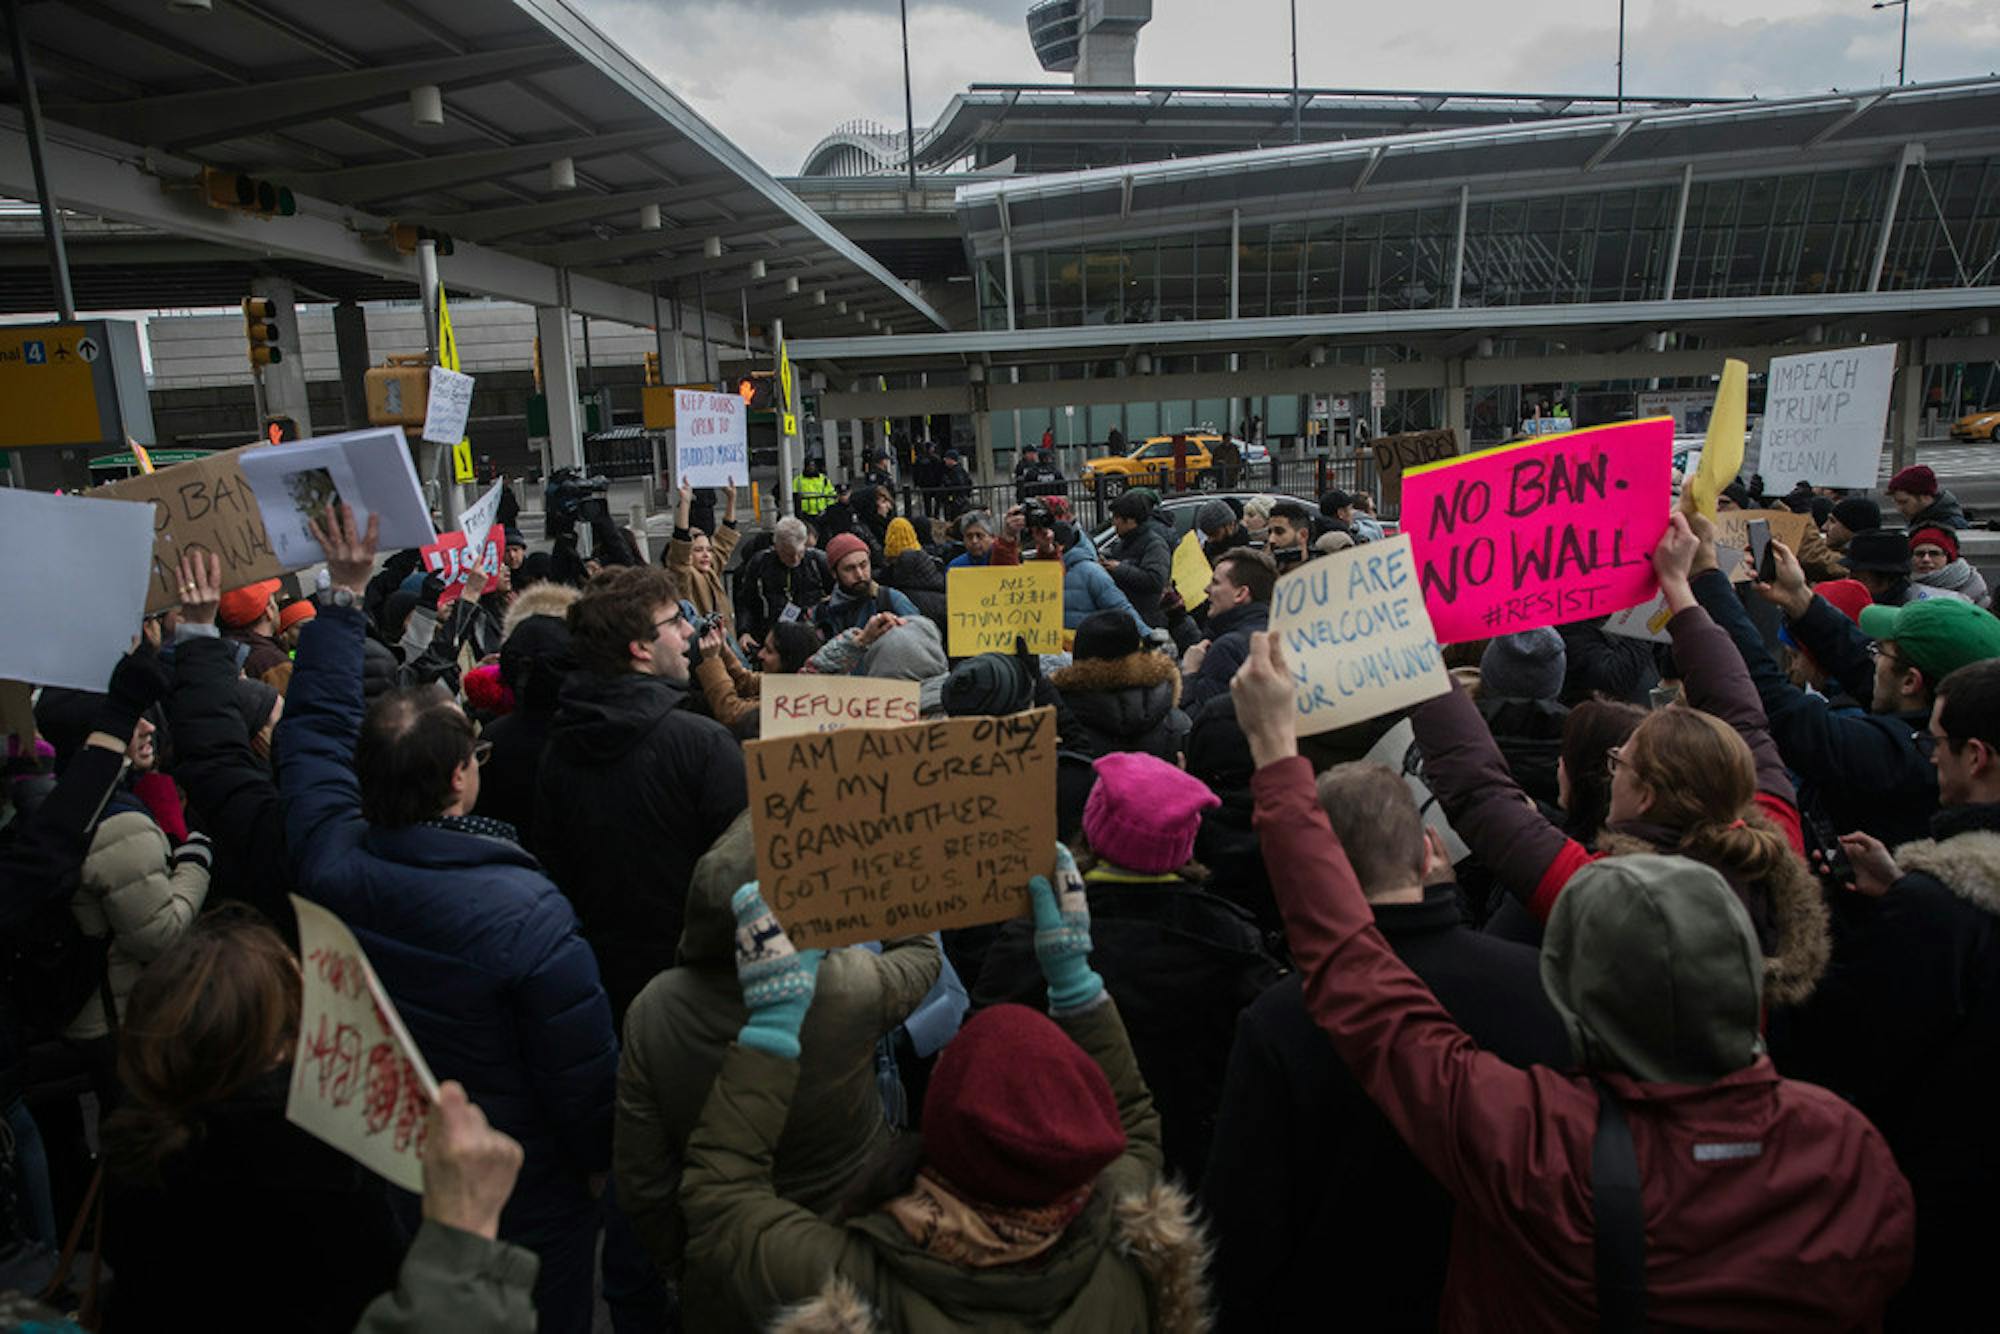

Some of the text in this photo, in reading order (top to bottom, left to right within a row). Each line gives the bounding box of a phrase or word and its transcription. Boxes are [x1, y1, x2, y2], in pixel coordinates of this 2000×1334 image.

[29, 342, 42, 361] 4
[1774, 358, 1859, 393] IMPEACH
[1773, 392, 1851, 424] TRUMP
[1769, 428, 1822, 447] DEPORT
[1769, 451, 1839, 475] MELANIA
[1429, 453, 1629, 541] NO BAN.
[214, 518, 275, 570] WAL
[1422, 523, 1654, 605] NO WALL.
[1275, 548, 1408, 619] YOU ARE
[952, 608, 1041, 628] NO WALL
[1287, 597, 1410, 653] WELCOME
[773, 694, 918, 723] REFUGEES
[1297, 684, 1336, 715] UR
[756, 711, 1046, 782] I AM ALIVE ONLY
[765, 780, 818, 829] B/C
[837, 771, 889, 814] MY
[768, 795, 1003, 871] GRANDMOTHER
[774, 826, 1032, 911] GOT HERE BEFORE
[841, 881, 893, 906] THE
[976, 855, 1029, 880] 1924
[788, 913, 871, 942] ATIONAL
[885, 894, 968, 928] ORIGINS
